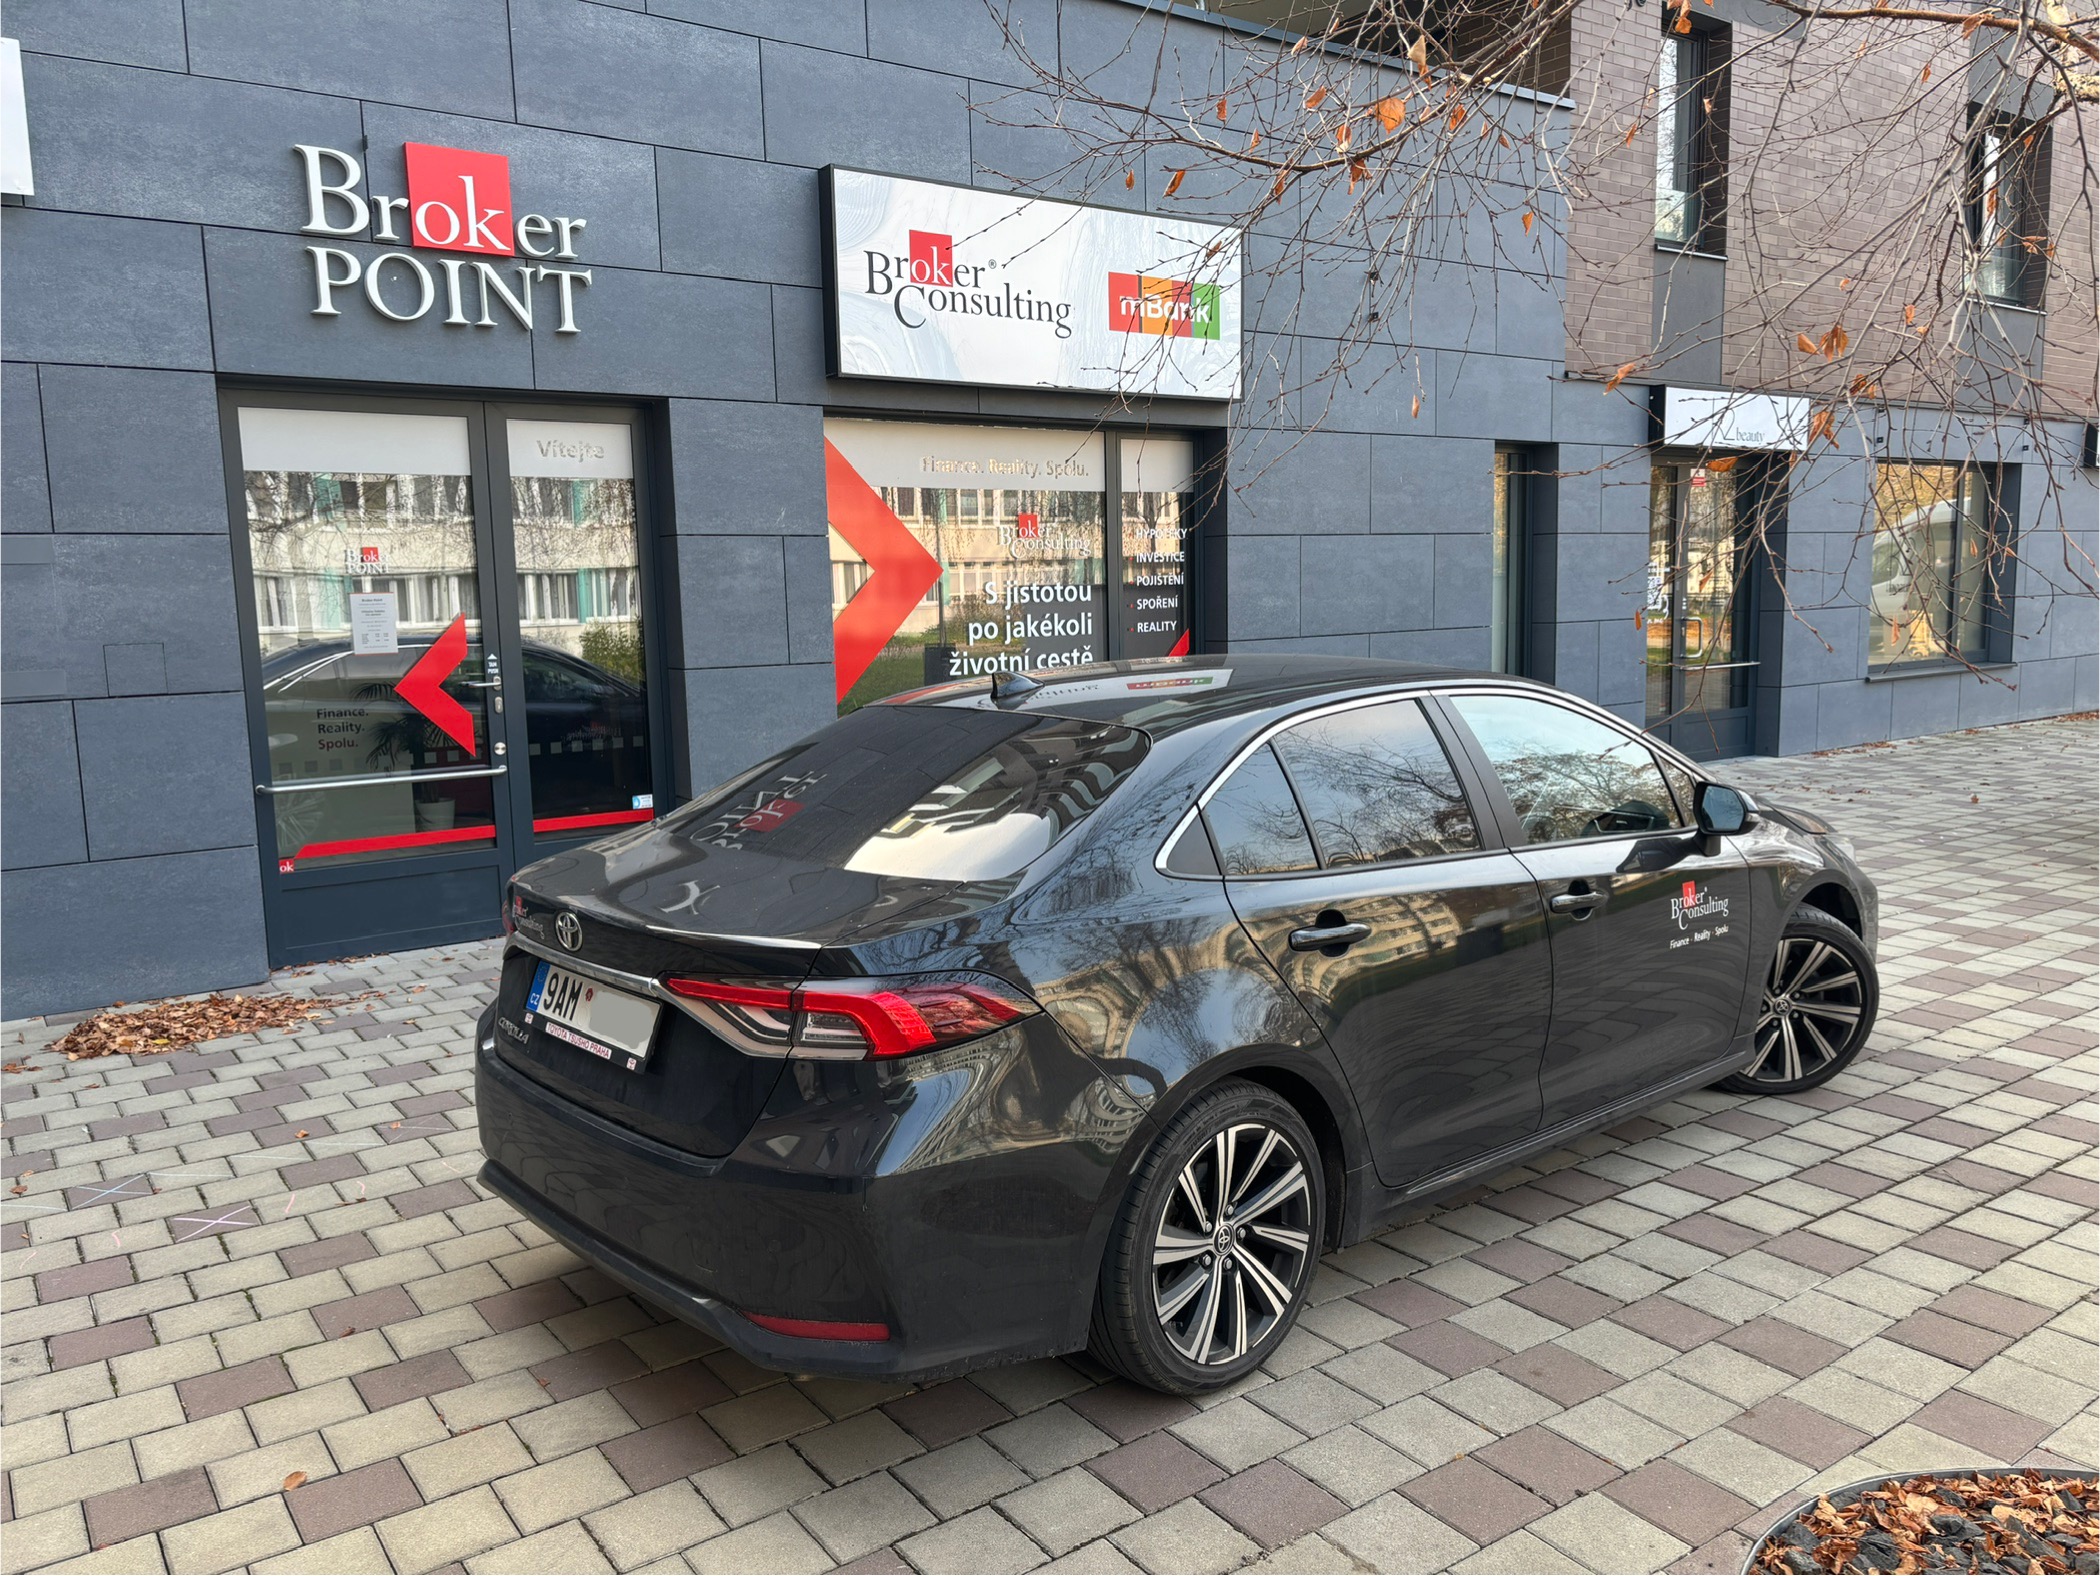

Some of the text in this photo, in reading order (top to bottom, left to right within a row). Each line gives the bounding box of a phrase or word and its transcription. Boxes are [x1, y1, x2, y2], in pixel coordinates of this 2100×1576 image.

[294, 143, 587, 259] Broker
[305, 246, 592, 334] POINT
[894, 284, 1073, 339] Consulting
[1119, 294, 1211, 324] mBank
[1736, 427, 1766, 445] beauty
[536, 439, 605, 463] Vítejte
[1136, 551, 1185, 563] INVESTICE
[1136, 572, 1185, 586] POJIŠTĚNÍ
[985, 580, 1092, 610] S jistotou
[1136, 595, 1179, 610] SPOŘENÍ
[968, 612, 1093, 646] po jakékoli
[1137, 620, 1177, 633] REALITY
[949, 645, 1094, 676] životní cestě
[316, 707, 369, 719] Finance.
[318, 722, 366, 734] Reality.
[318, 738, 359, 751] Spolu.
[280, 860, 295, 873] ok
[1679, 896, 1729, 930] Consulting
[530, 993, 540, 1006] CZ
[548, 1023, 610, 1058] TOYOTA TSUSHO PRAHA
